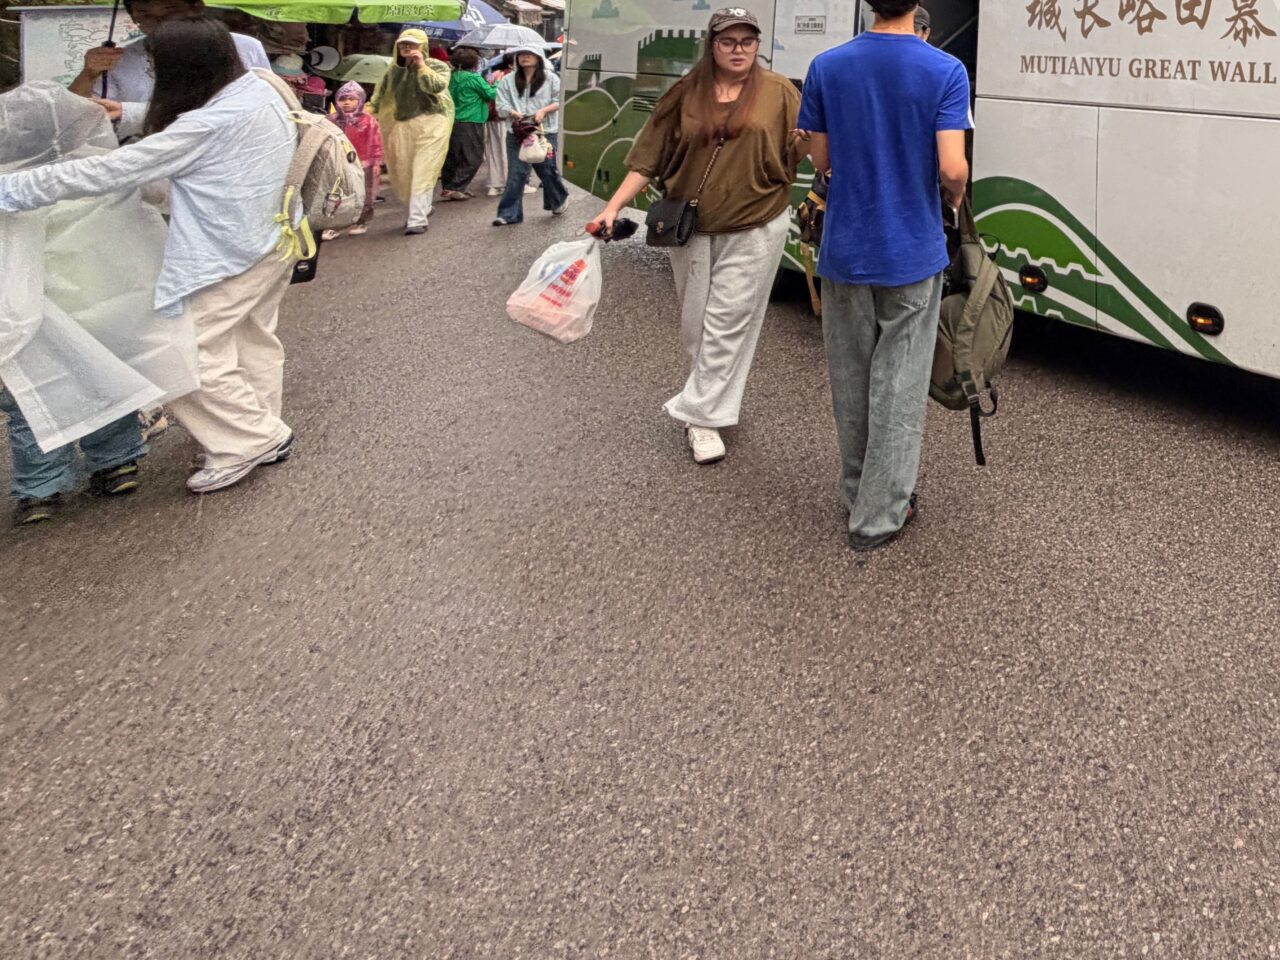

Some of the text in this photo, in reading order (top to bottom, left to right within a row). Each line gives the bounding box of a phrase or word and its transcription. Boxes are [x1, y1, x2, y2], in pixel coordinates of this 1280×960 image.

[1019, 55, 1277, 84] MUTIANYU GREAT WALL
